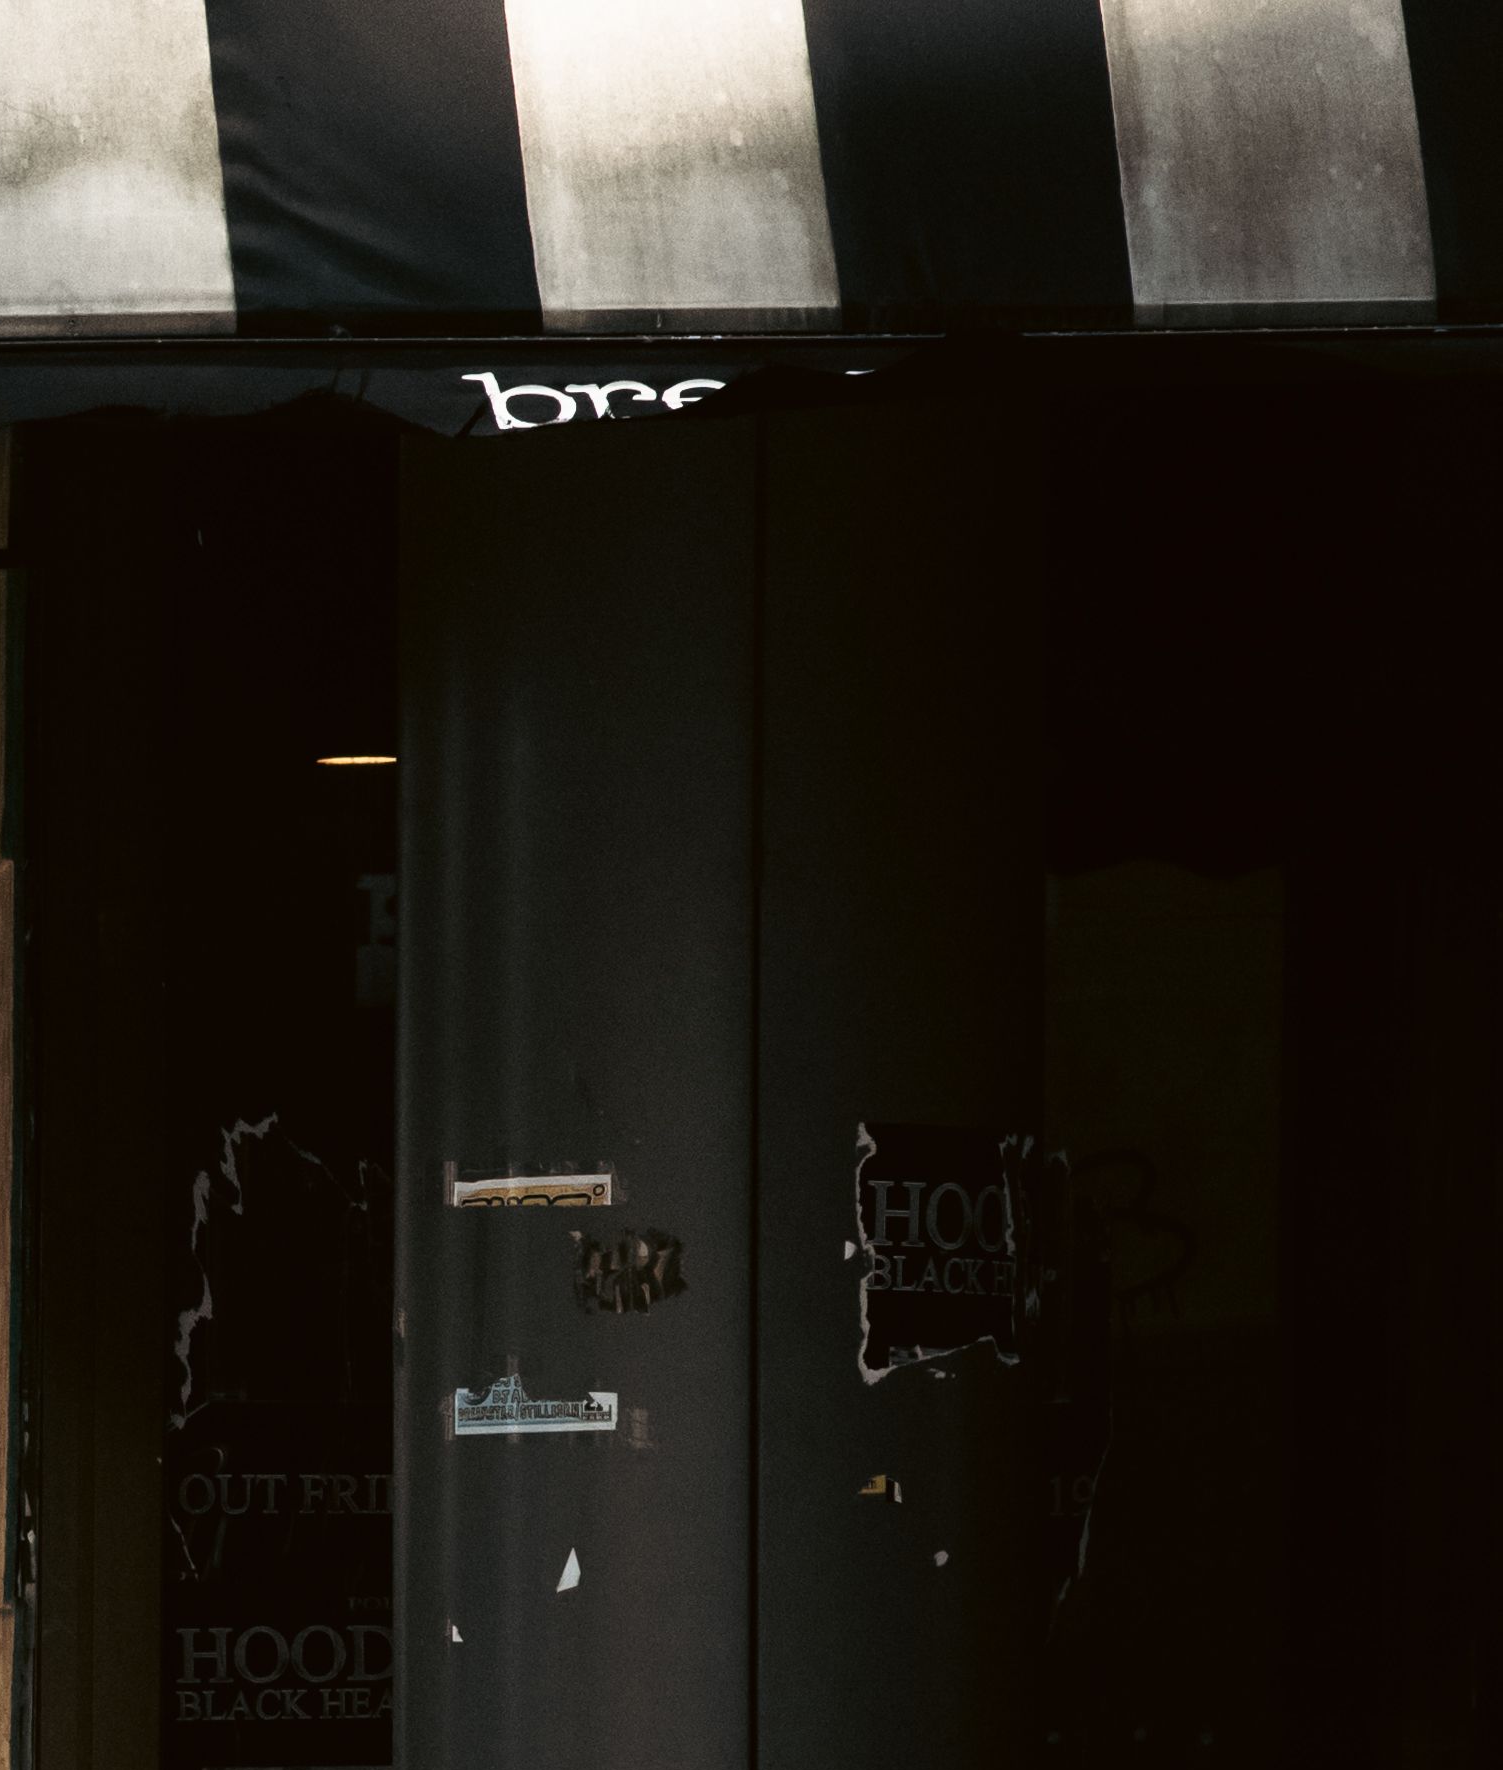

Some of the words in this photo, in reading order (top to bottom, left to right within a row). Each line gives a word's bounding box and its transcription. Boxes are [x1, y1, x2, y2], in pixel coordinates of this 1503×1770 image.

[178, 1473, 288, 1516] OUT
[174, 1624, 393, 1684] HOOD
[174, 1688, 312, 1721] BLACK
